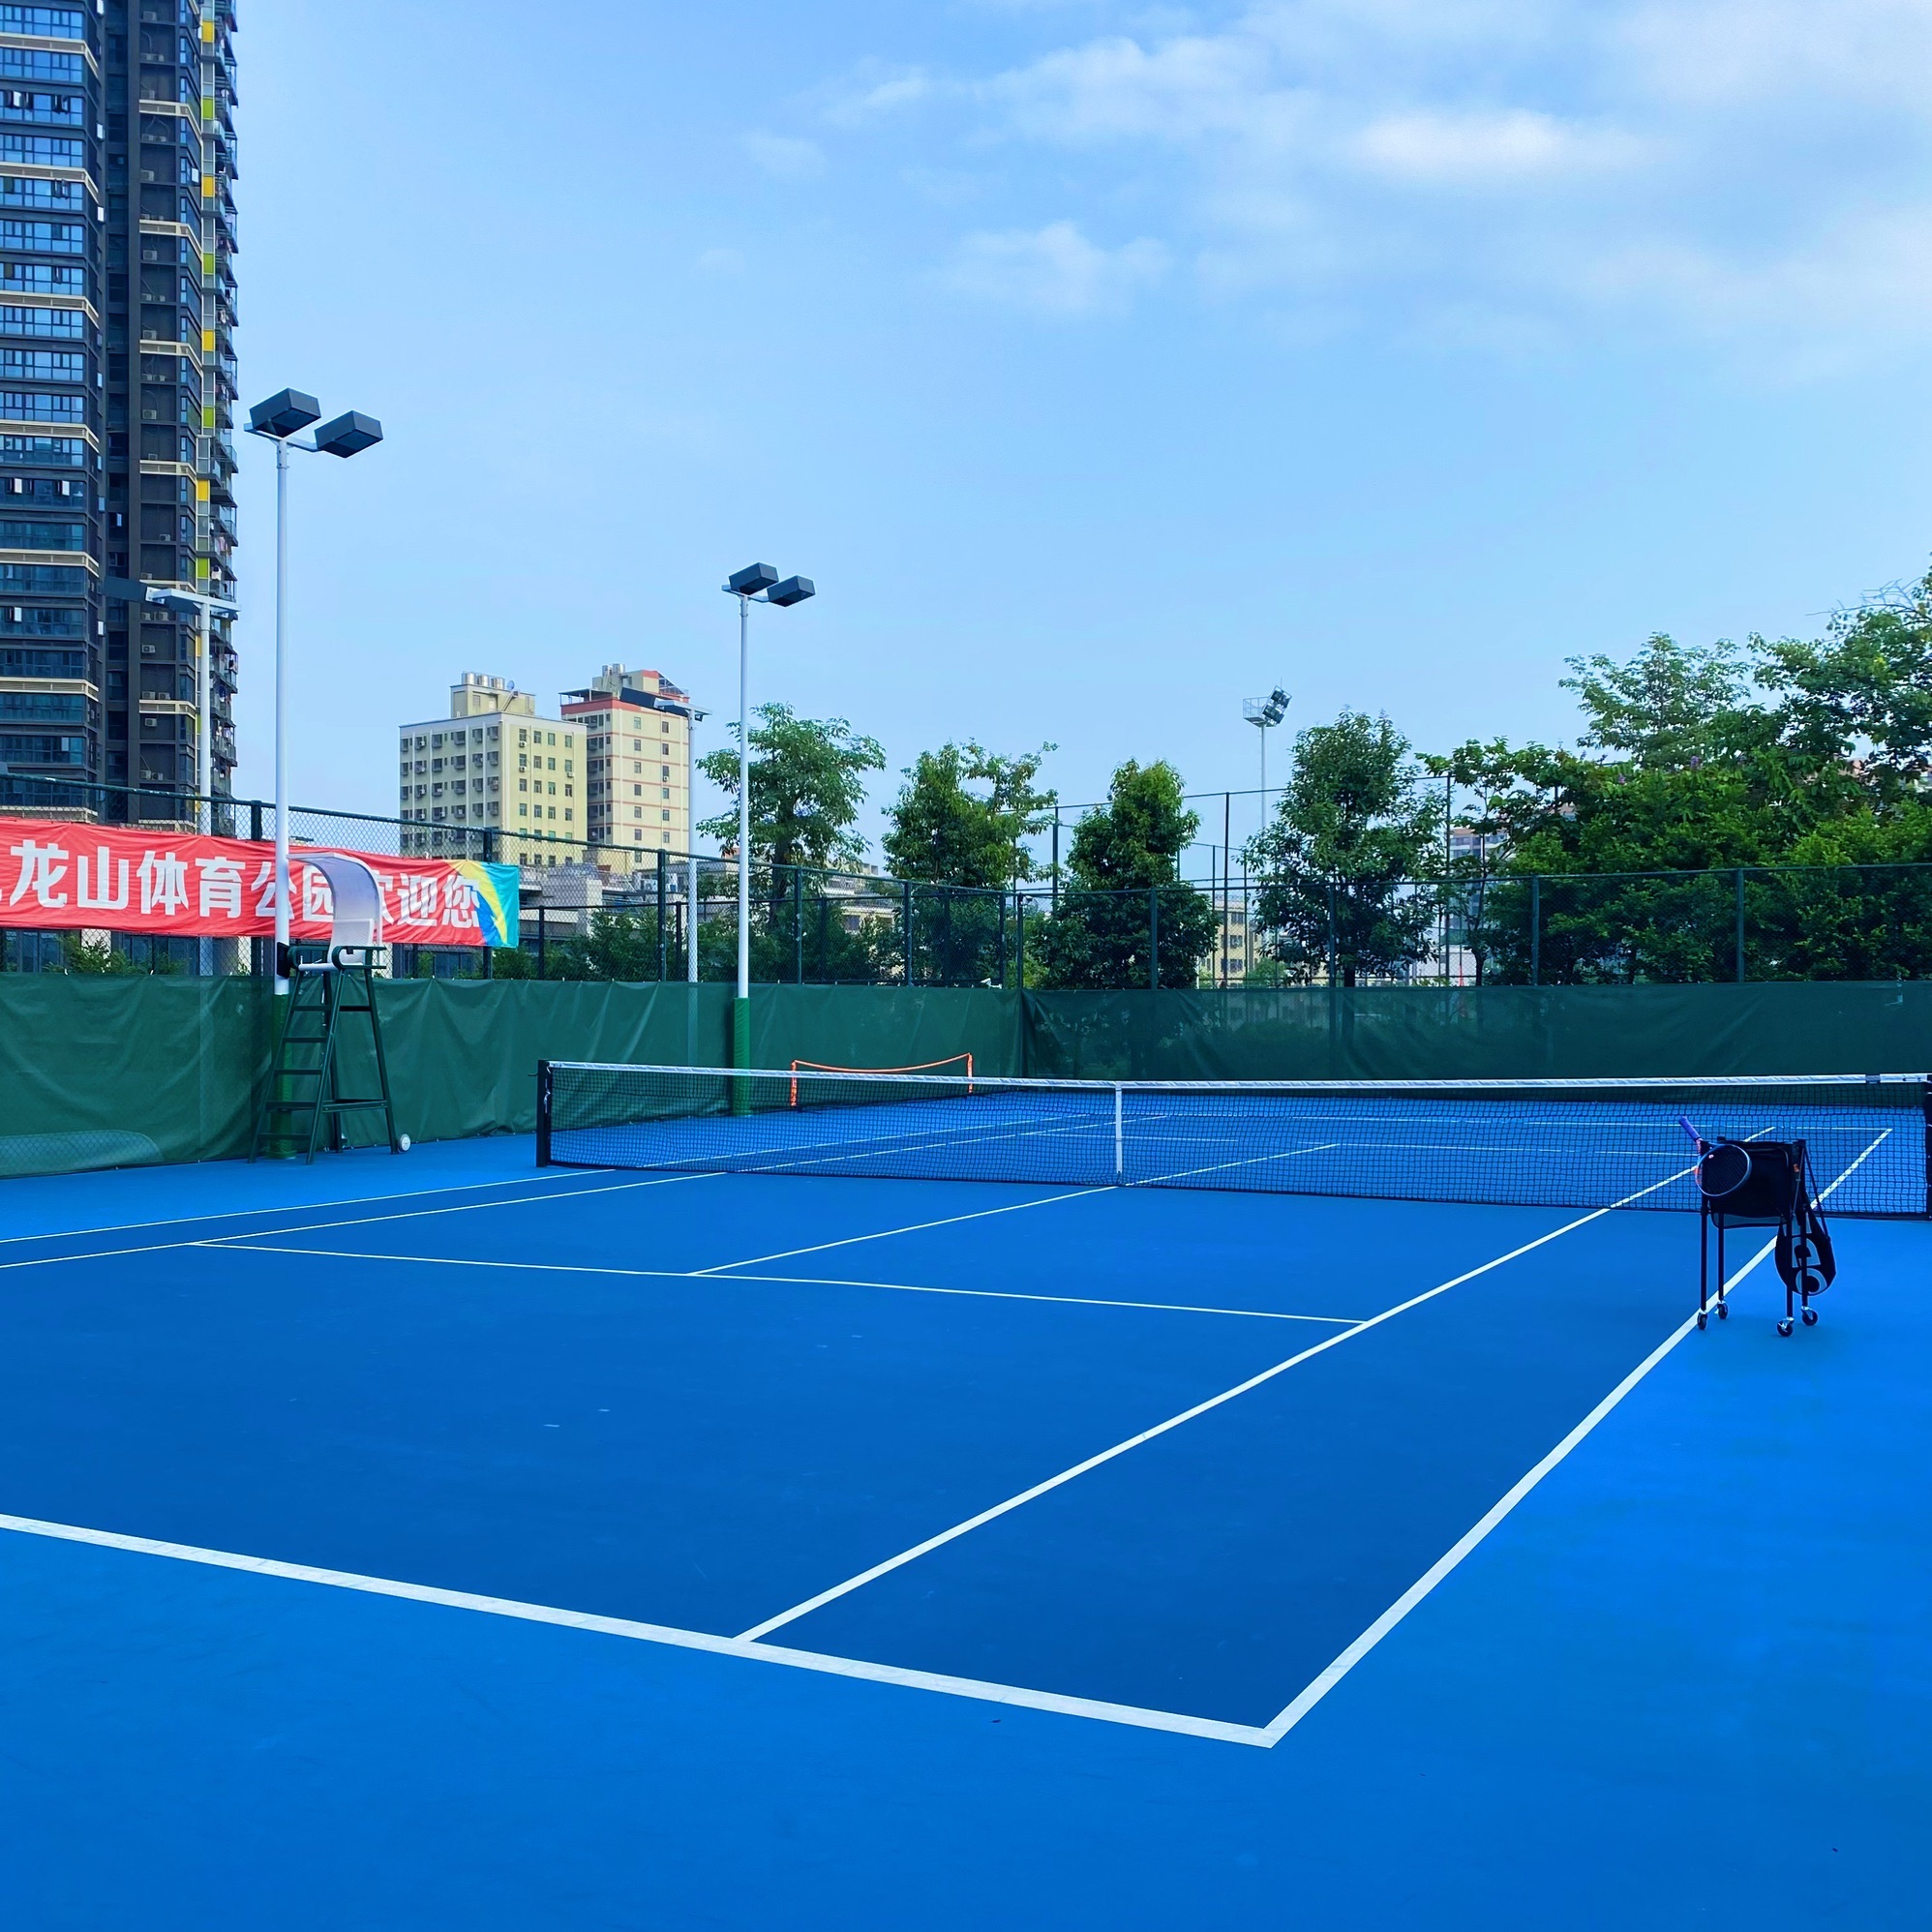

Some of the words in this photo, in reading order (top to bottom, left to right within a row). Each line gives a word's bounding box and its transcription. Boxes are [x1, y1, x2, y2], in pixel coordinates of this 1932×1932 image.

[0, 838, 482, 928] 龙山体育公园迎您
